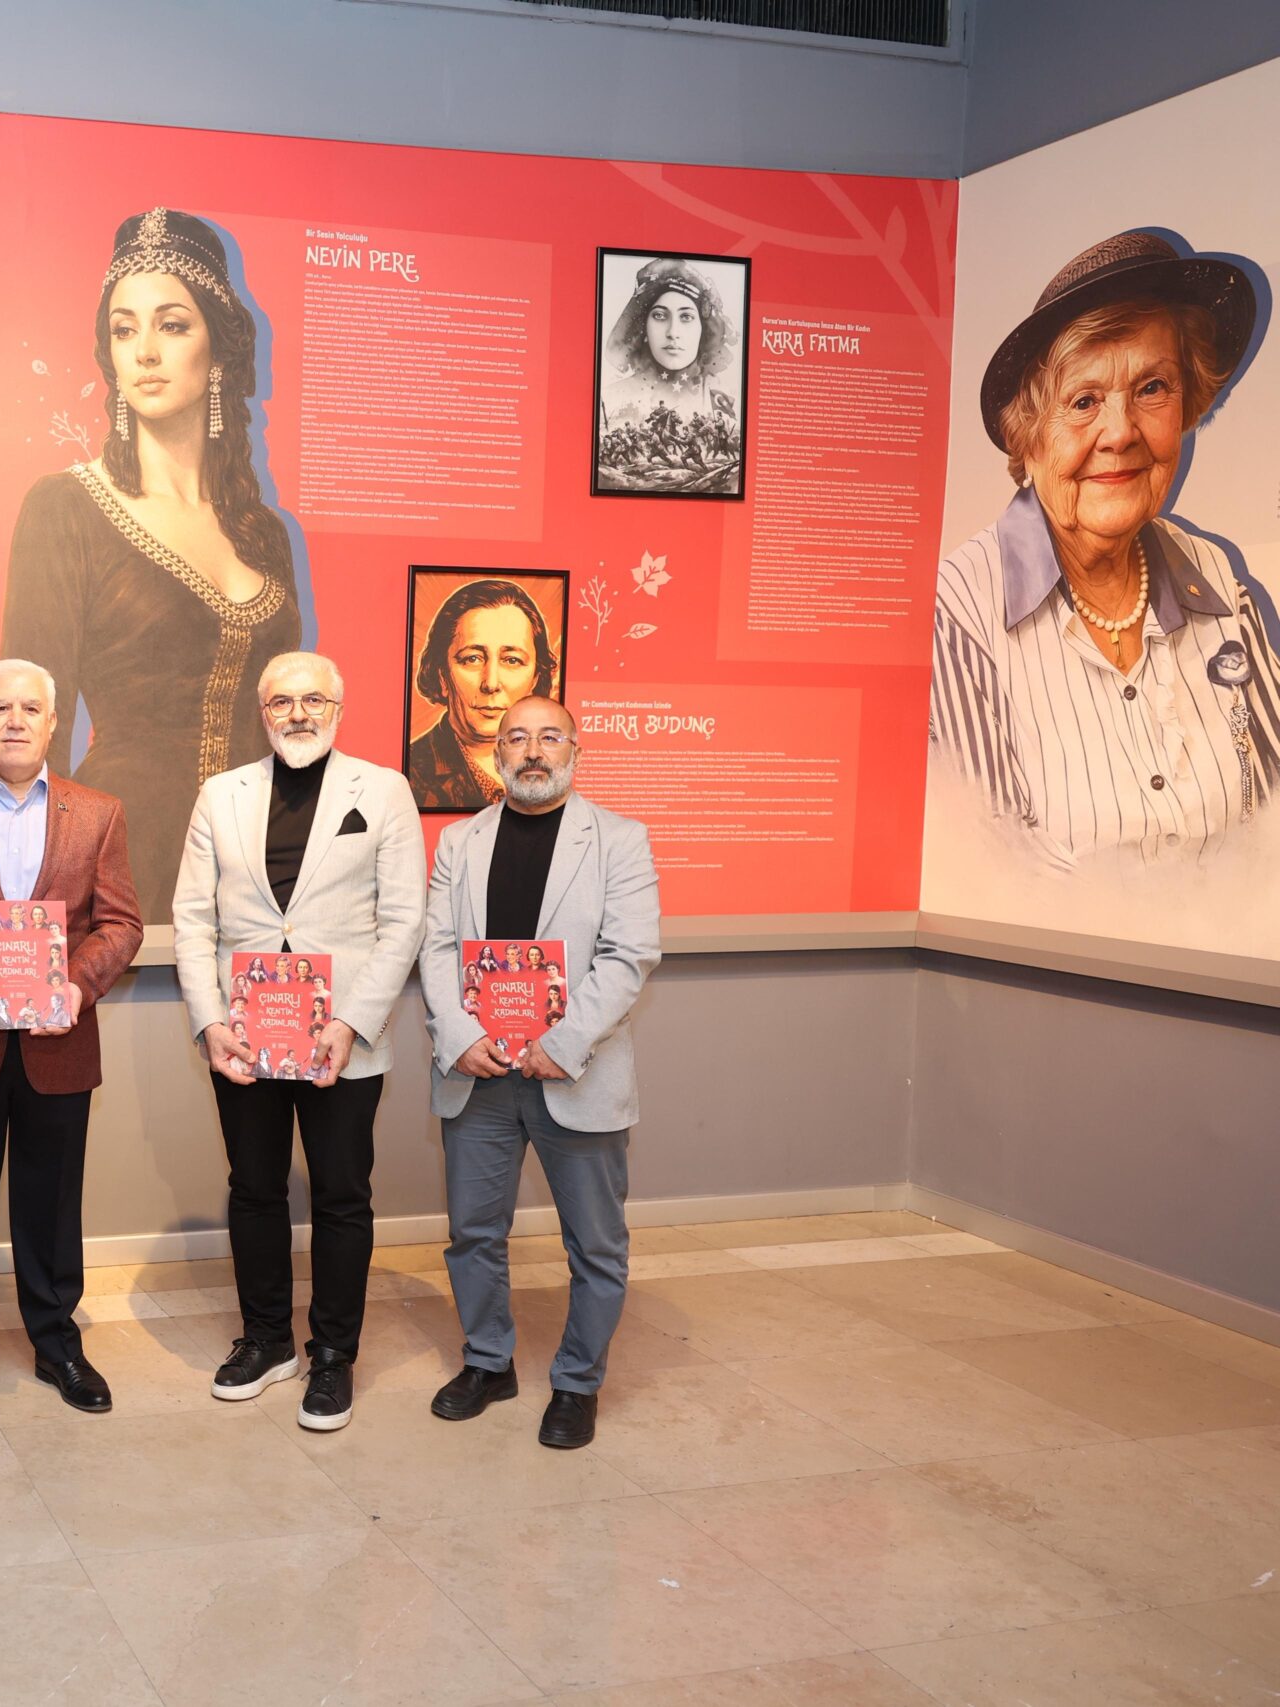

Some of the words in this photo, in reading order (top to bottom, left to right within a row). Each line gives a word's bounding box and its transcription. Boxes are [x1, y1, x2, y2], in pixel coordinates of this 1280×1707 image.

[306, 244, 360, 269] NEVİN
[369, 250, 419, 282] PERE
[762, 329, 804, 356] KARA
[810, 334, 860, 354] FATMA
[582, 715, 639, 740] ZEHRA
[645, 715, 715, 740] BUDUNÇ
